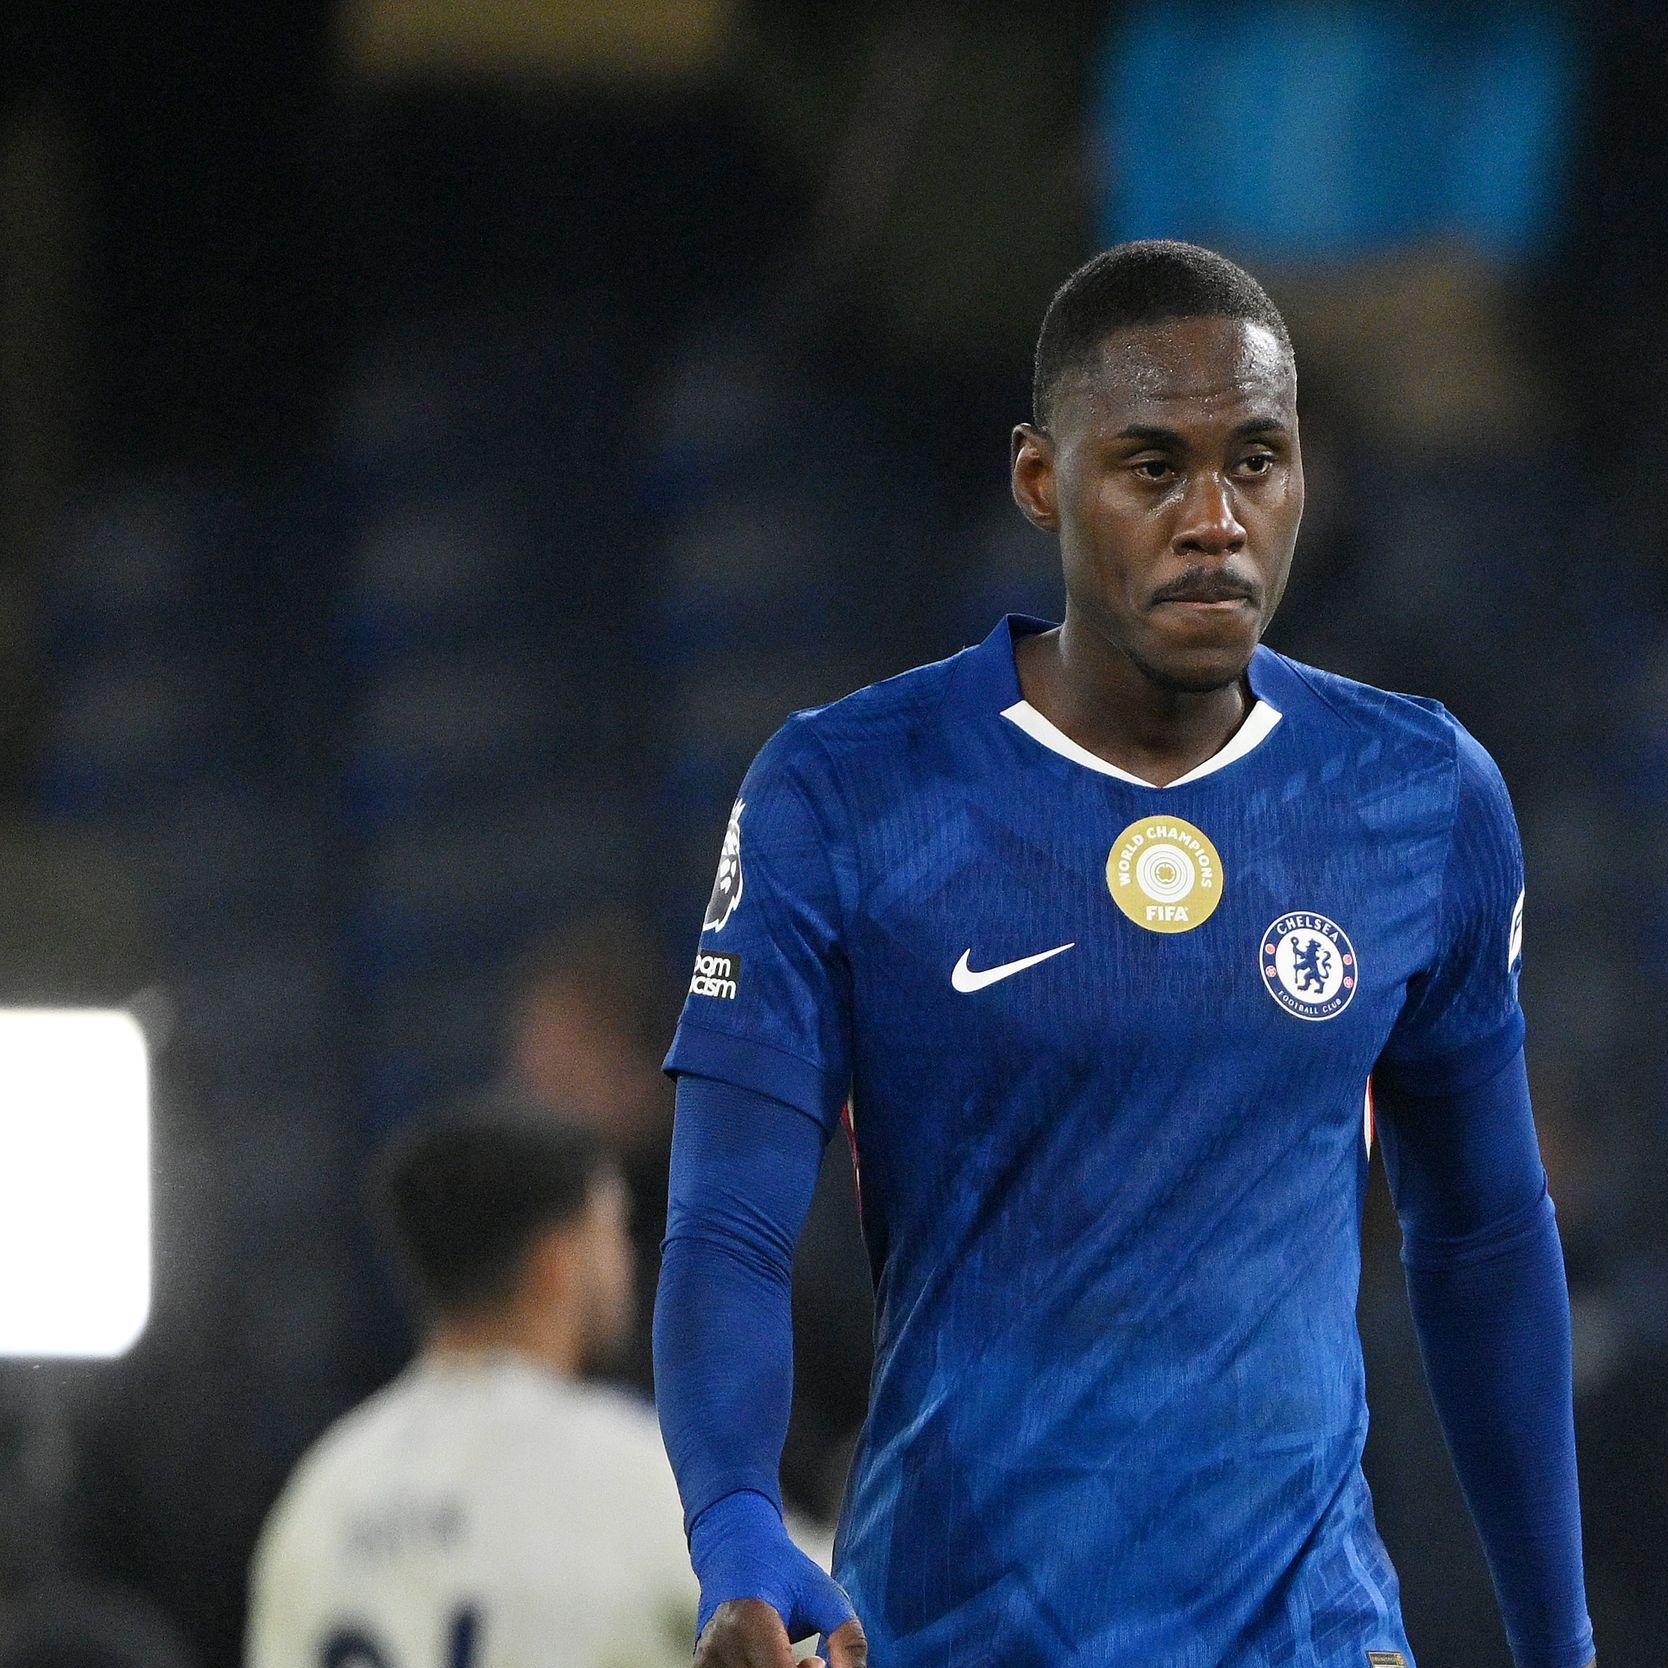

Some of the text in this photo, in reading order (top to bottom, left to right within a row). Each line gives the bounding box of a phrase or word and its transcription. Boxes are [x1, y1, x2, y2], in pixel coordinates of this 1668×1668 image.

[1118, 825, 1213, 889] WORLD CHAMPIONS
[1146, 905, 1189, 922] FIFA
[1276, 916, 1341, 943] CHELSEA
[1278, 990, 1318, 1014] FOOTBALL
